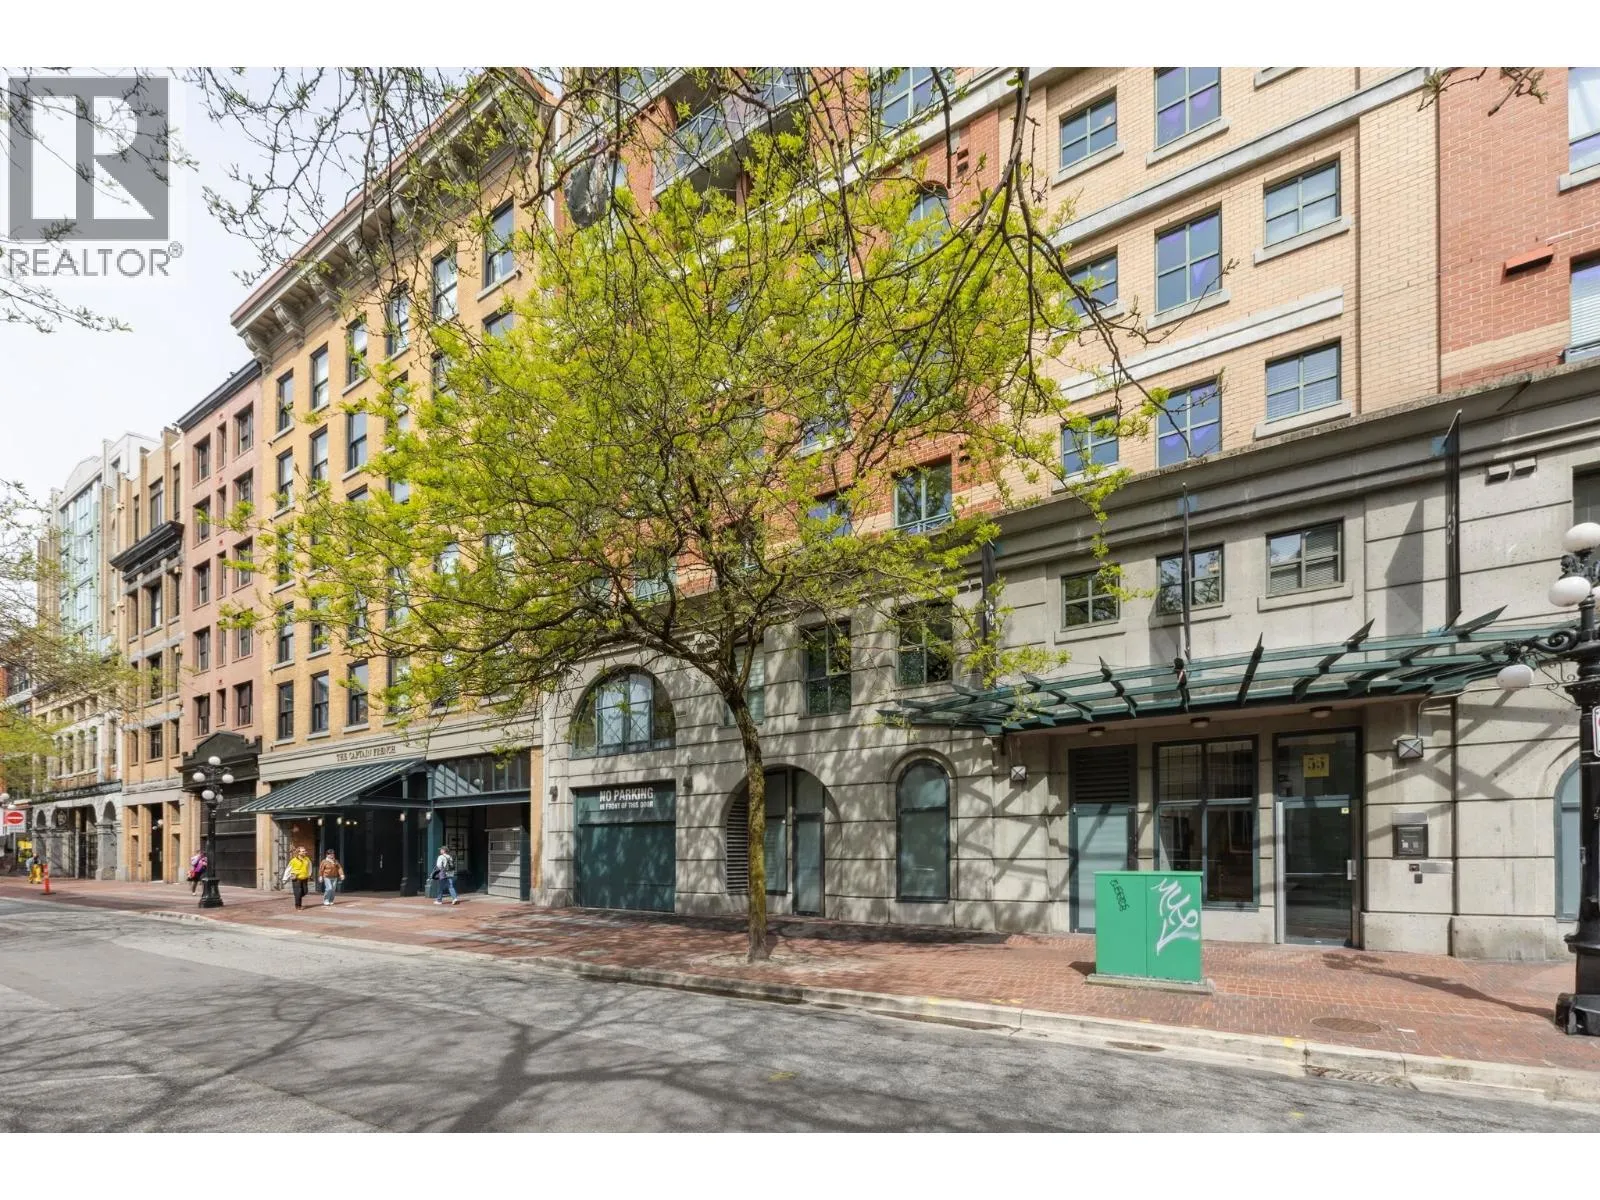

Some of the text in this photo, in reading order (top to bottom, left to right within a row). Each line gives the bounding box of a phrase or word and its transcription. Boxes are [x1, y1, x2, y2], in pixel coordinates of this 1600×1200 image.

[336, 746, 395, 761] THE CAPTAIN FRENCH
[599, 787, 654, 802] NO PARKING
[628, 801, 639, 809] THIS
